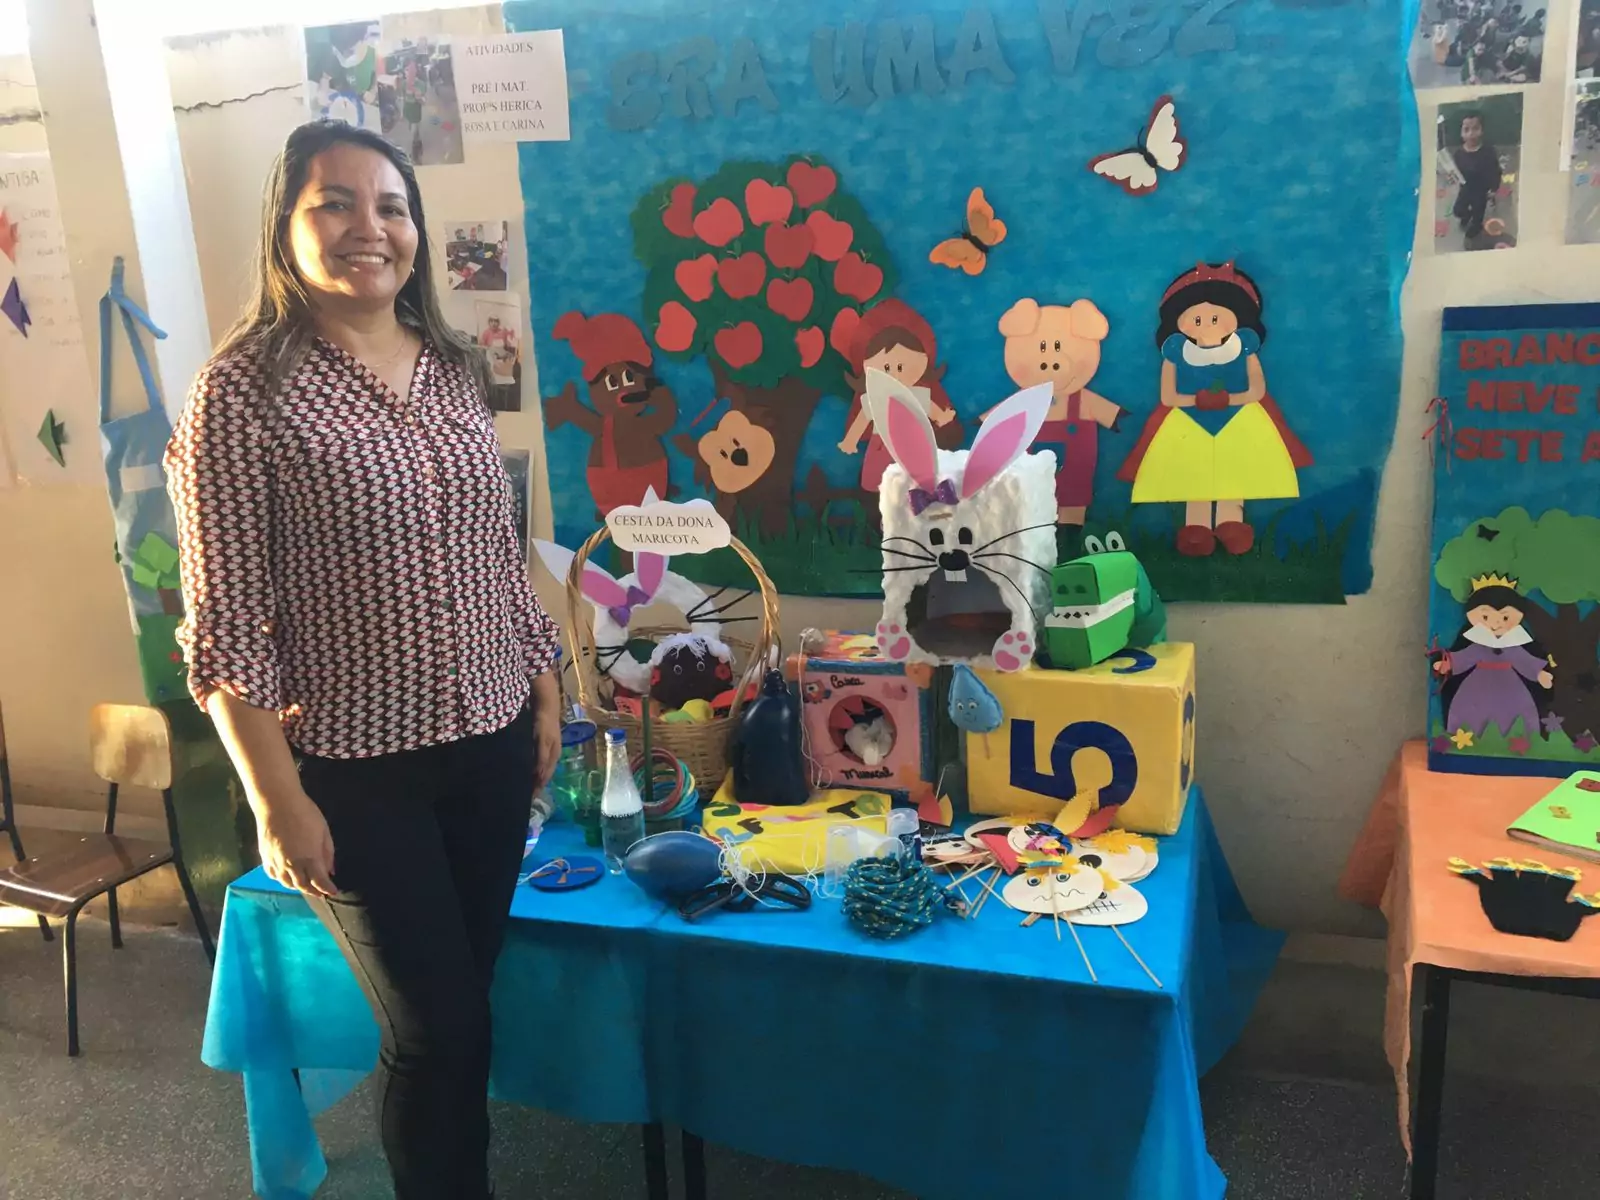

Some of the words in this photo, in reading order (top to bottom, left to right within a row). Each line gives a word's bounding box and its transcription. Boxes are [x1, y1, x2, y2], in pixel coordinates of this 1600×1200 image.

[467, 42, 533, 55] ATIVIDADES
[606, 36, 780, 131] ERA
[809, 6, 1016, 108] UMA
[500, 100, 543, 112] HERICA
[464, 121, 493, 133] ROSA
[502, 119, 545, 130] CARINA
[1467, 380, 1580, 414] NEVE
[1455, 427, 1563, 463] SETE
[614, 515, 653, 527] CESTA
[656, 516, 674, 527] DA
[677, 516, 714, 528] DONA
[632, 533, 700, 544] MARICOTA
